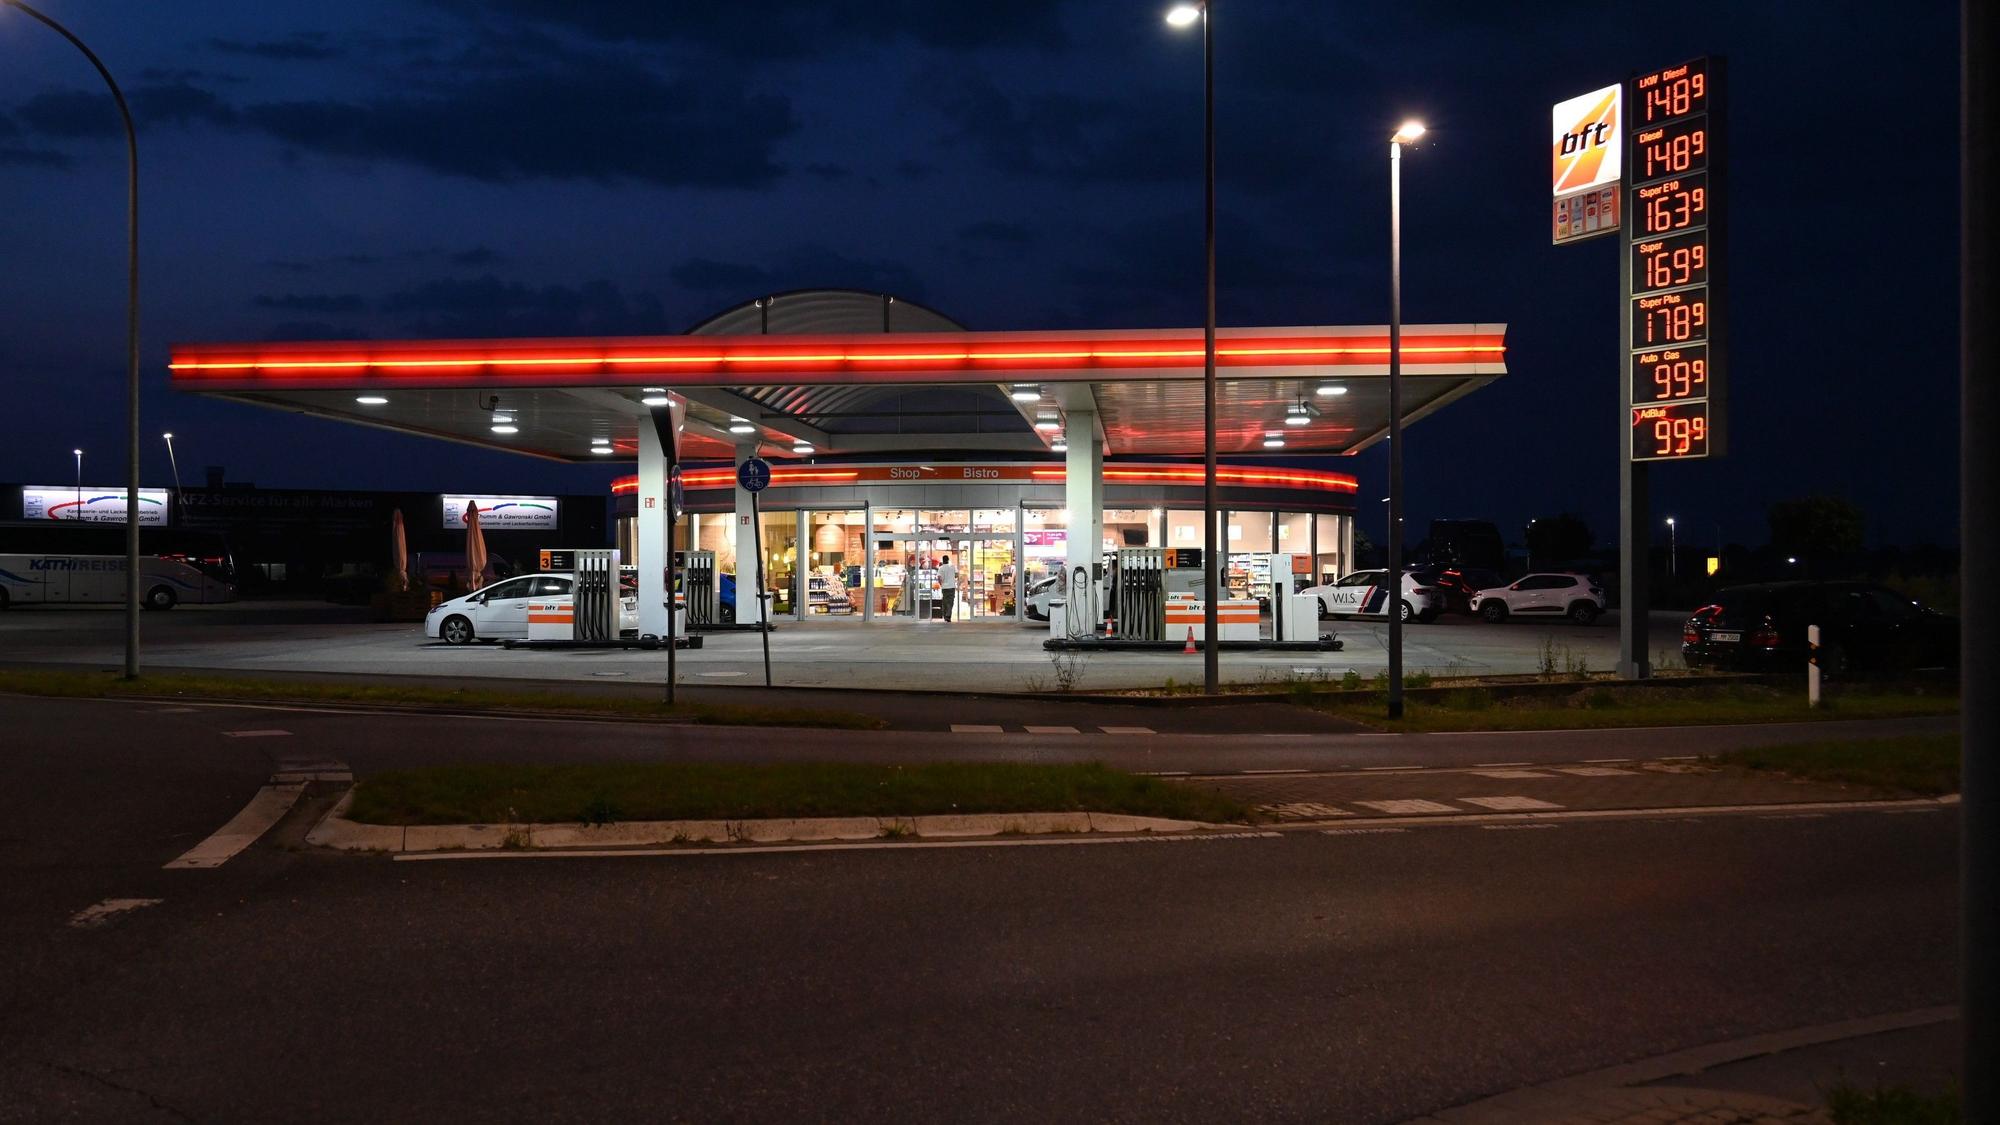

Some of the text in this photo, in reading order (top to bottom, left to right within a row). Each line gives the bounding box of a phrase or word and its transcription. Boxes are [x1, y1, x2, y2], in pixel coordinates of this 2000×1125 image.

[1640, 65, 1687, 88] LKW Diesel
[1560, 122, 1608, 156] bft
[1640, 129, 1663, 143] Diesel
[1640, 181, 1679, 198] Super E10
[1640, 242, 1663, 253] Super
[1640, 295, 1680, 309] Super Plus
[1640, 351, 1680, 364] Auto Gas
[1640, 408, 1666, 419] AdBlue
[890, 467, 920, 479] Shop
[963, 467, 999, 478] Bistro
[79, 560, 128, 571] REISE
[542, 558, 549, 568] 3
[1167, 556, 1174, 566] 1
[1332, 593, 1357, 603] W.I.S.
